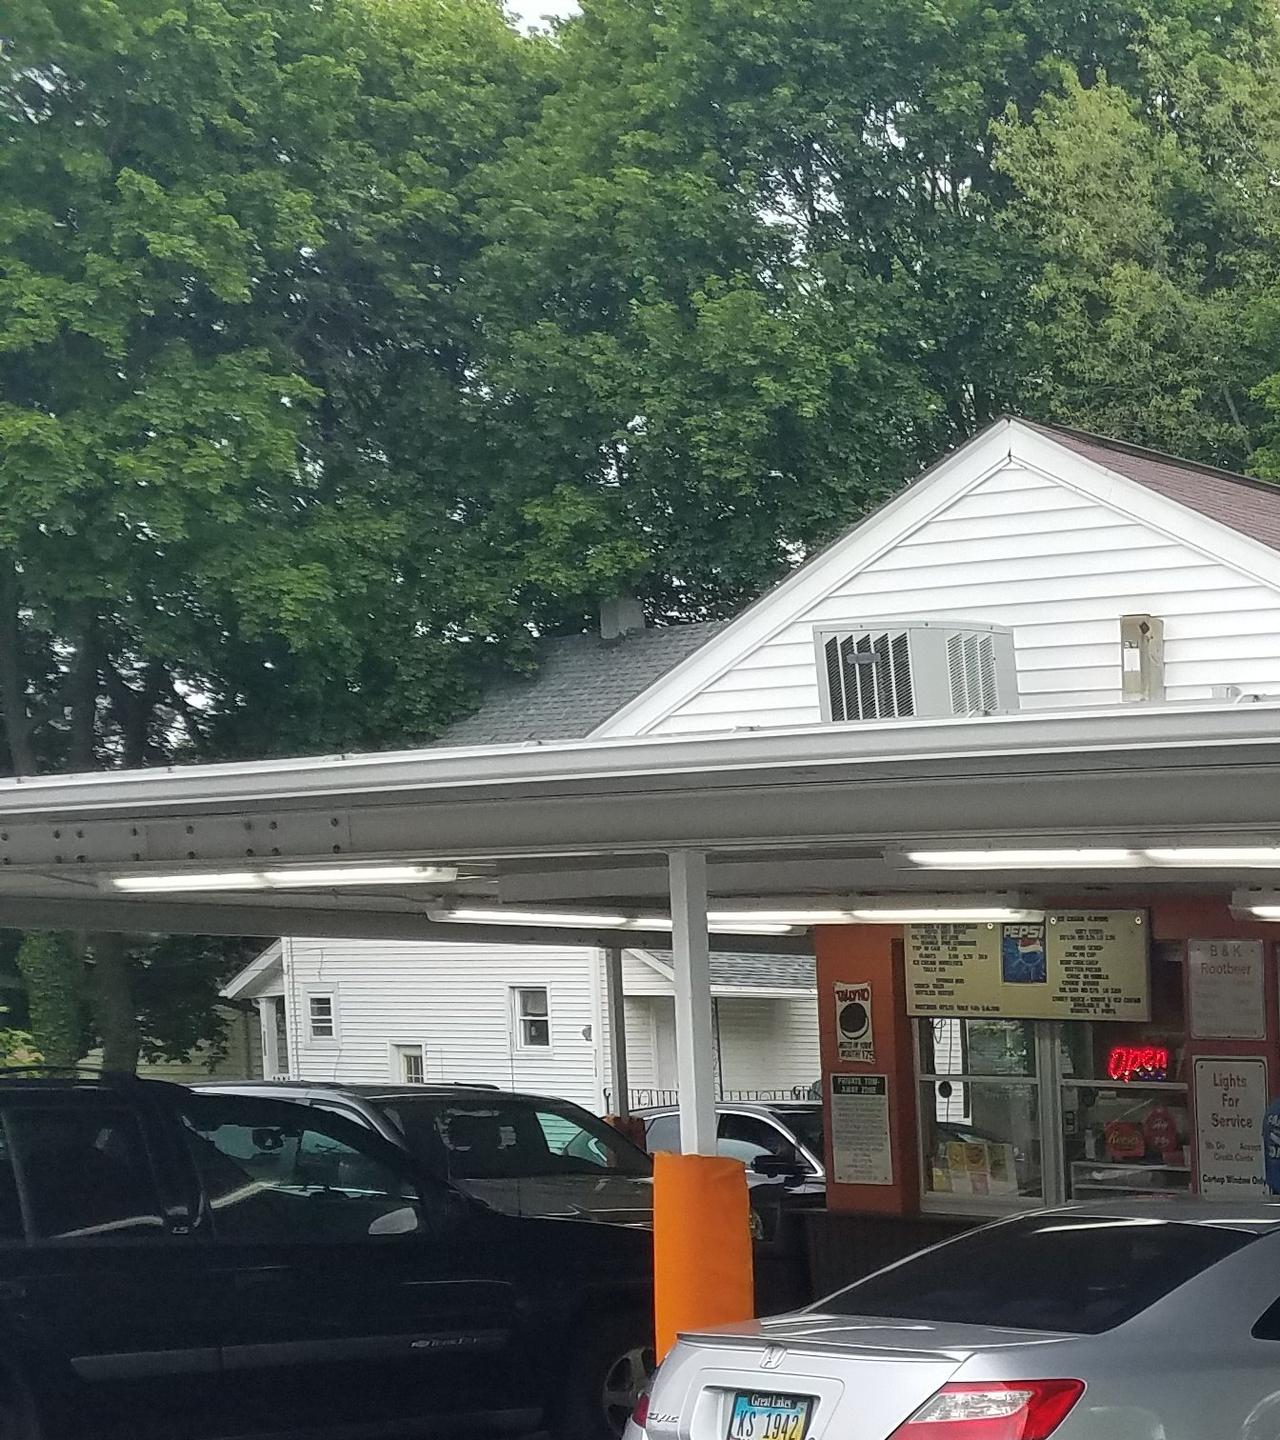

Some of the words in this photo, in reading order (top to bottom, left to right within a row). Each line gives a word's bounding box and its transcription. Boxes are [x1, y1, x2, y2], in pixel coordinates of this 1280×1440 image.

[1004, 925, 1045, 939] PEPSI
[1210, 945, 1217, 957] B
[1221, 945, 1229, 957] &
[1233, 945, 1242, 957] K
[1213, 1072, 1248, 1091] Lights
[1222, 1093, 1240, 1107] For
[1211, 1112, 1253, 1129] Service
[751, 1394, 772, 1407] Great
[772, 1396, 793, 1408] Lakes
[737, 1409, 757, 1437] KS
